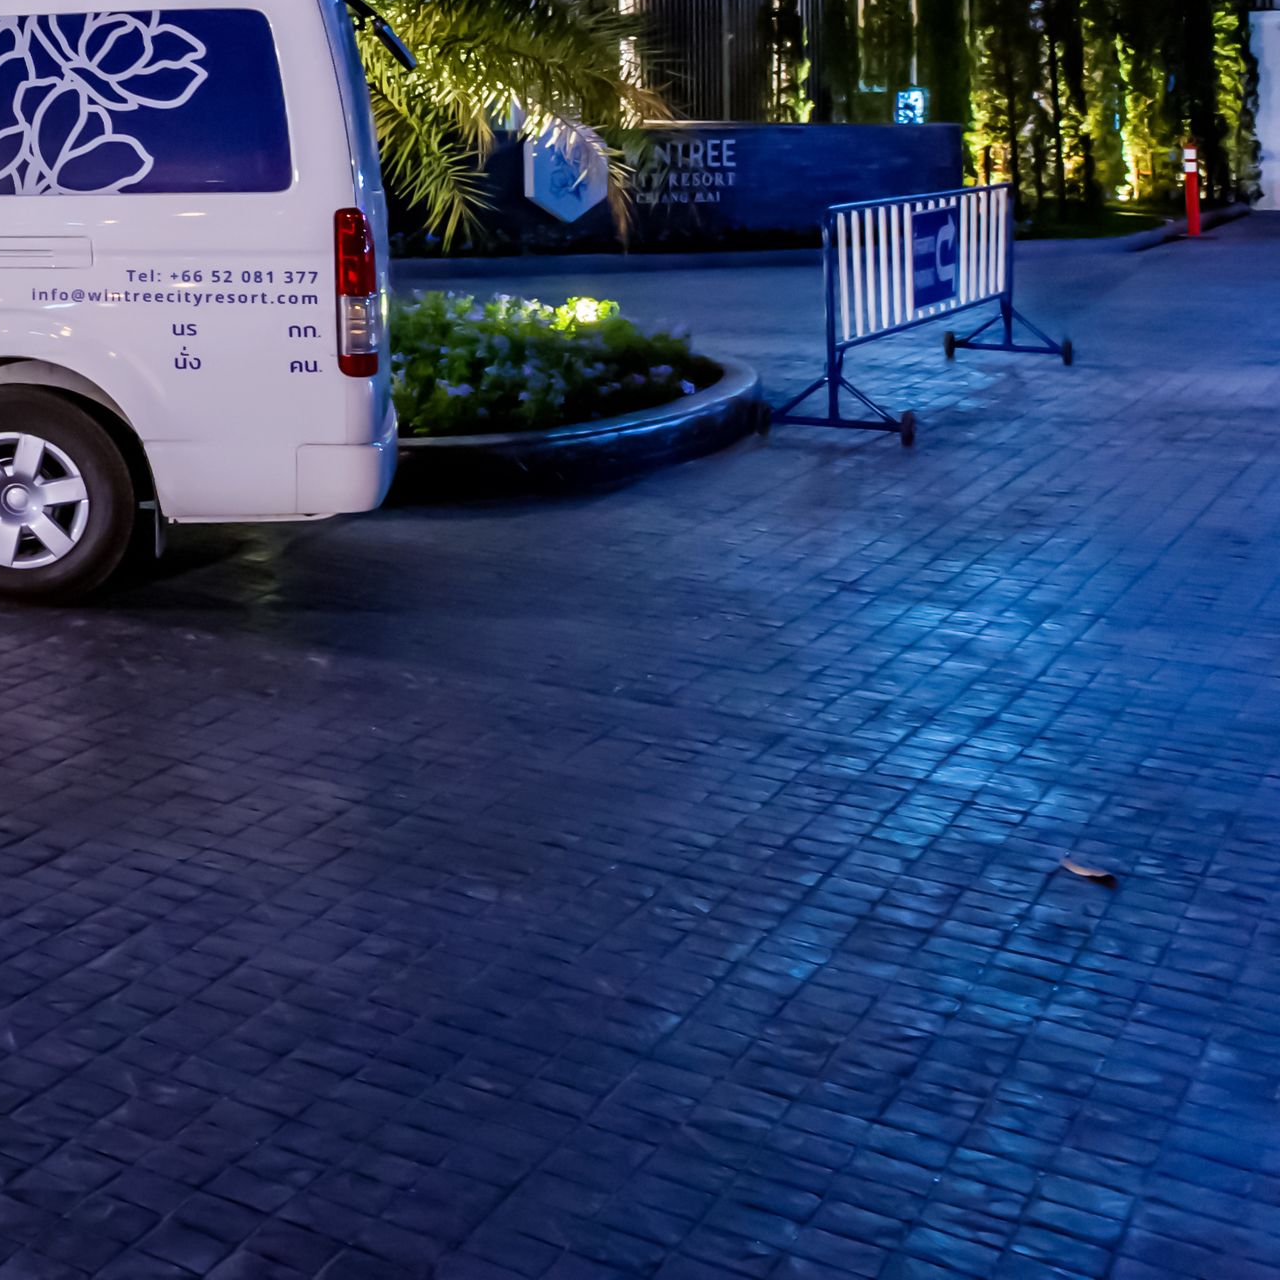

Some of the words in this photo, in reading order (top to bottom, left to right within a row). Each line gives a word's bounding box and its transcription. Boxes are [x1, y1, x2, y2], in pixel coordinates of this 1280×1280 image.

[668, 172, 736, 187] RESORT
[126, 269, 162, 283] Tel:
[170, 269, 203, 283] +66
[211, 270, 233, 283] 52
[241, 270, 274, 284] 081
[284, 270, 319, 284] 377
[32, 288, 319, 307] info@wintreecityresort.com
[172, 323, 198, 337] นร
[288, 324, 322, 338] กก.
[174, 346, 202, 370] นั่ง
[289, 359, 323, 373] คน.
